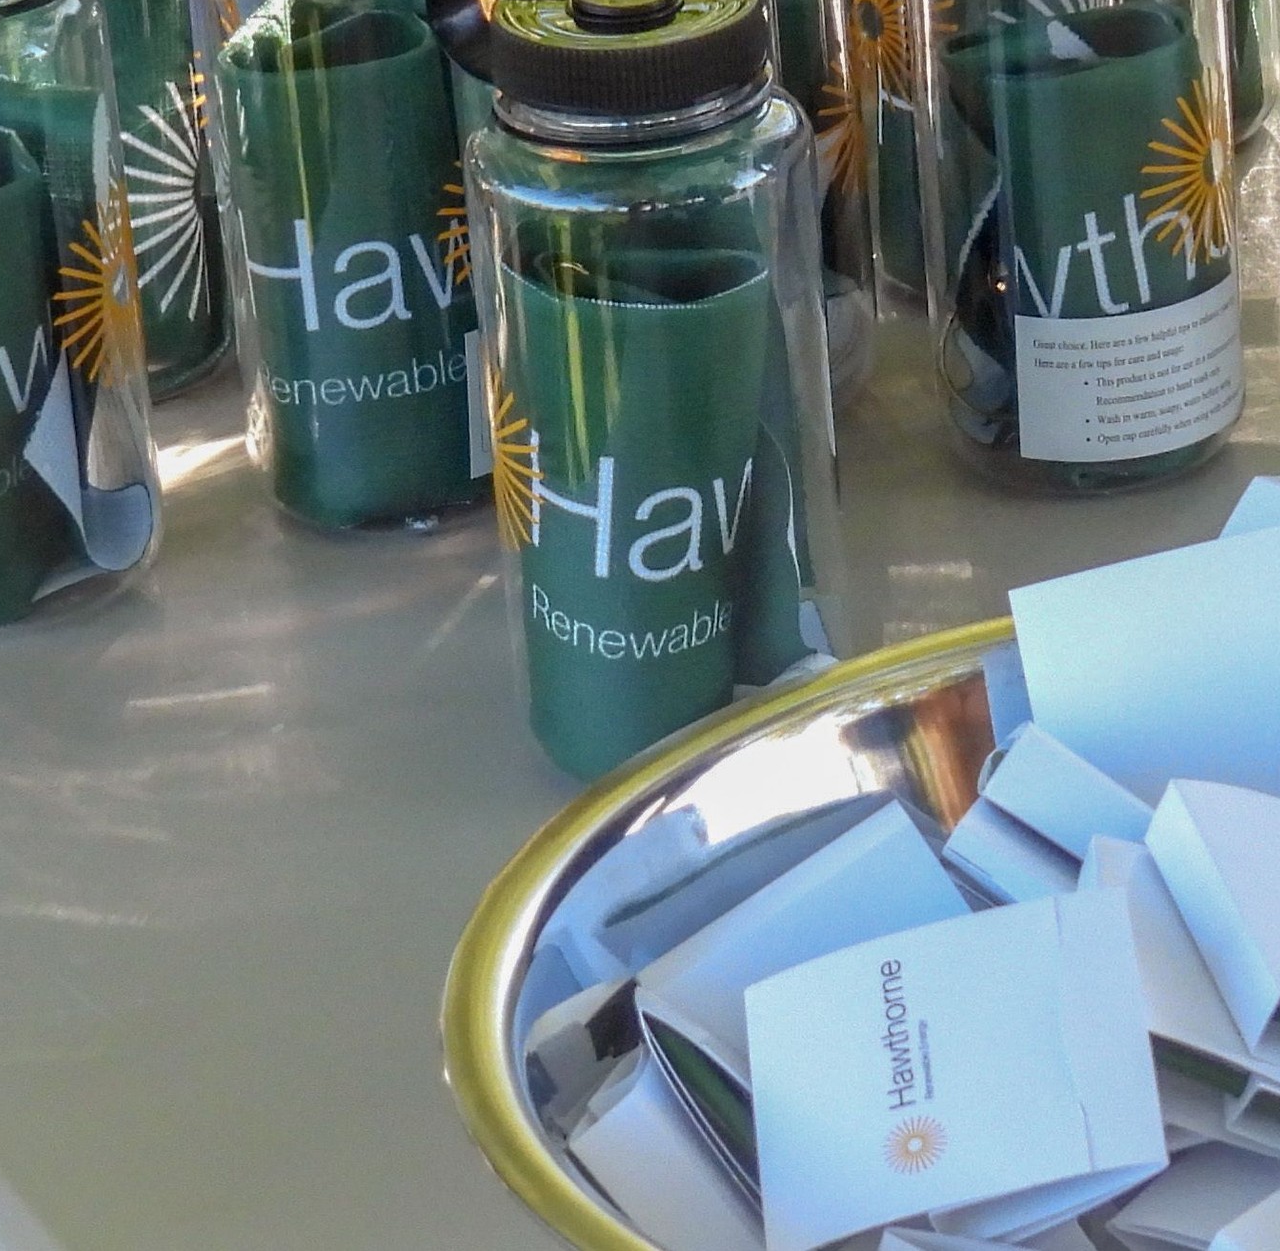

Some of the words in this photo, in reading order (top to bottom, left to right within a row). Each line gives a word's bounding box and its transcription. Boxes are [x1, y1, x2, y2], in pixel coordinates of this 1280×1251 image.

[1090, 339, 1111, 350] Here
[1113, 339, 1126, 348] are
[1134, 334, 1149, 344] few
[1034, 357, 1055, 368] Here
[1056, 361, 1069, 369] are
[1078, 358, 1093, 369] few
[1096, 359, 1112, 370] tips
[1113, 356, 1126, 367] for
[1127, 354, 1145, 365] care
[1146, 350, 1161, 362] and
[1096, 376, 1115, 387] This
[1116, 373, 1147, 388] product
[1157, 368, 1169, 378] not
[1176, 378, 1192, 391] hand
[1097, 414, 1121, 424] Wash
[1097, 433, 1121, 445] Open
[1122, 433, 1137, 442] cap
[1138, 423, 1172, 438] carefully
[531, 582, 734, 660] Renewable
[880, 958, 918, 1111] Hawthorne
